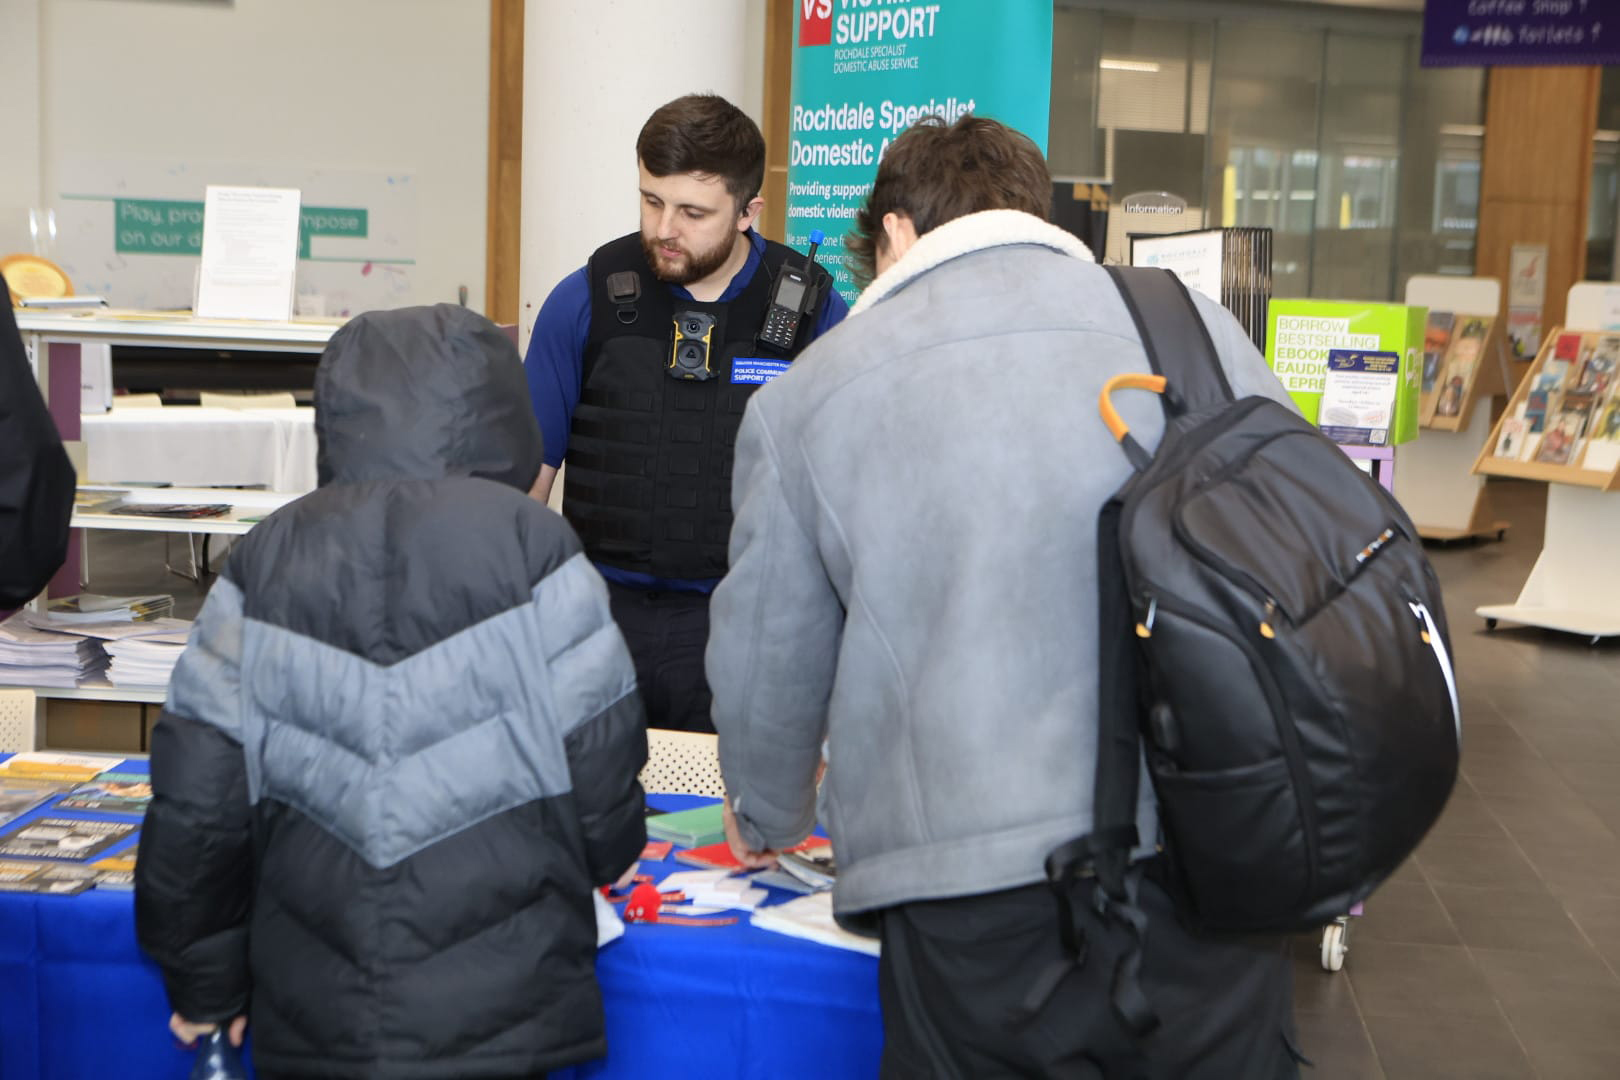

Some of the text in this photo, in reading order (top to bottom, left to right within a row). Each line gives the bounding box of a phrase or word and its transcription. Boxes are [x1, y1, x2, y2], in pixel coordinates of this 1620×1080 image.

[835, 4, 940, 45] SUPPORT
[834, 44, 907, 60] ROCHDALE SPECIALIST
[833, 56, 919, 74] DOMESTIC ABUSE SERVICE
[793, 101, 875, 132] Rochdale
[791, 138, 874, 167] Domestic
[789, 181, 870, 200] Providing support
[788, 203, 825, 218] domestic
[1125, 203, 1182, 215] Information
[835, 269, 849, 283] We
[1278, 319, 1345, 332] BORROW
[1278, 333, 1376, 348] BESTSELLING
